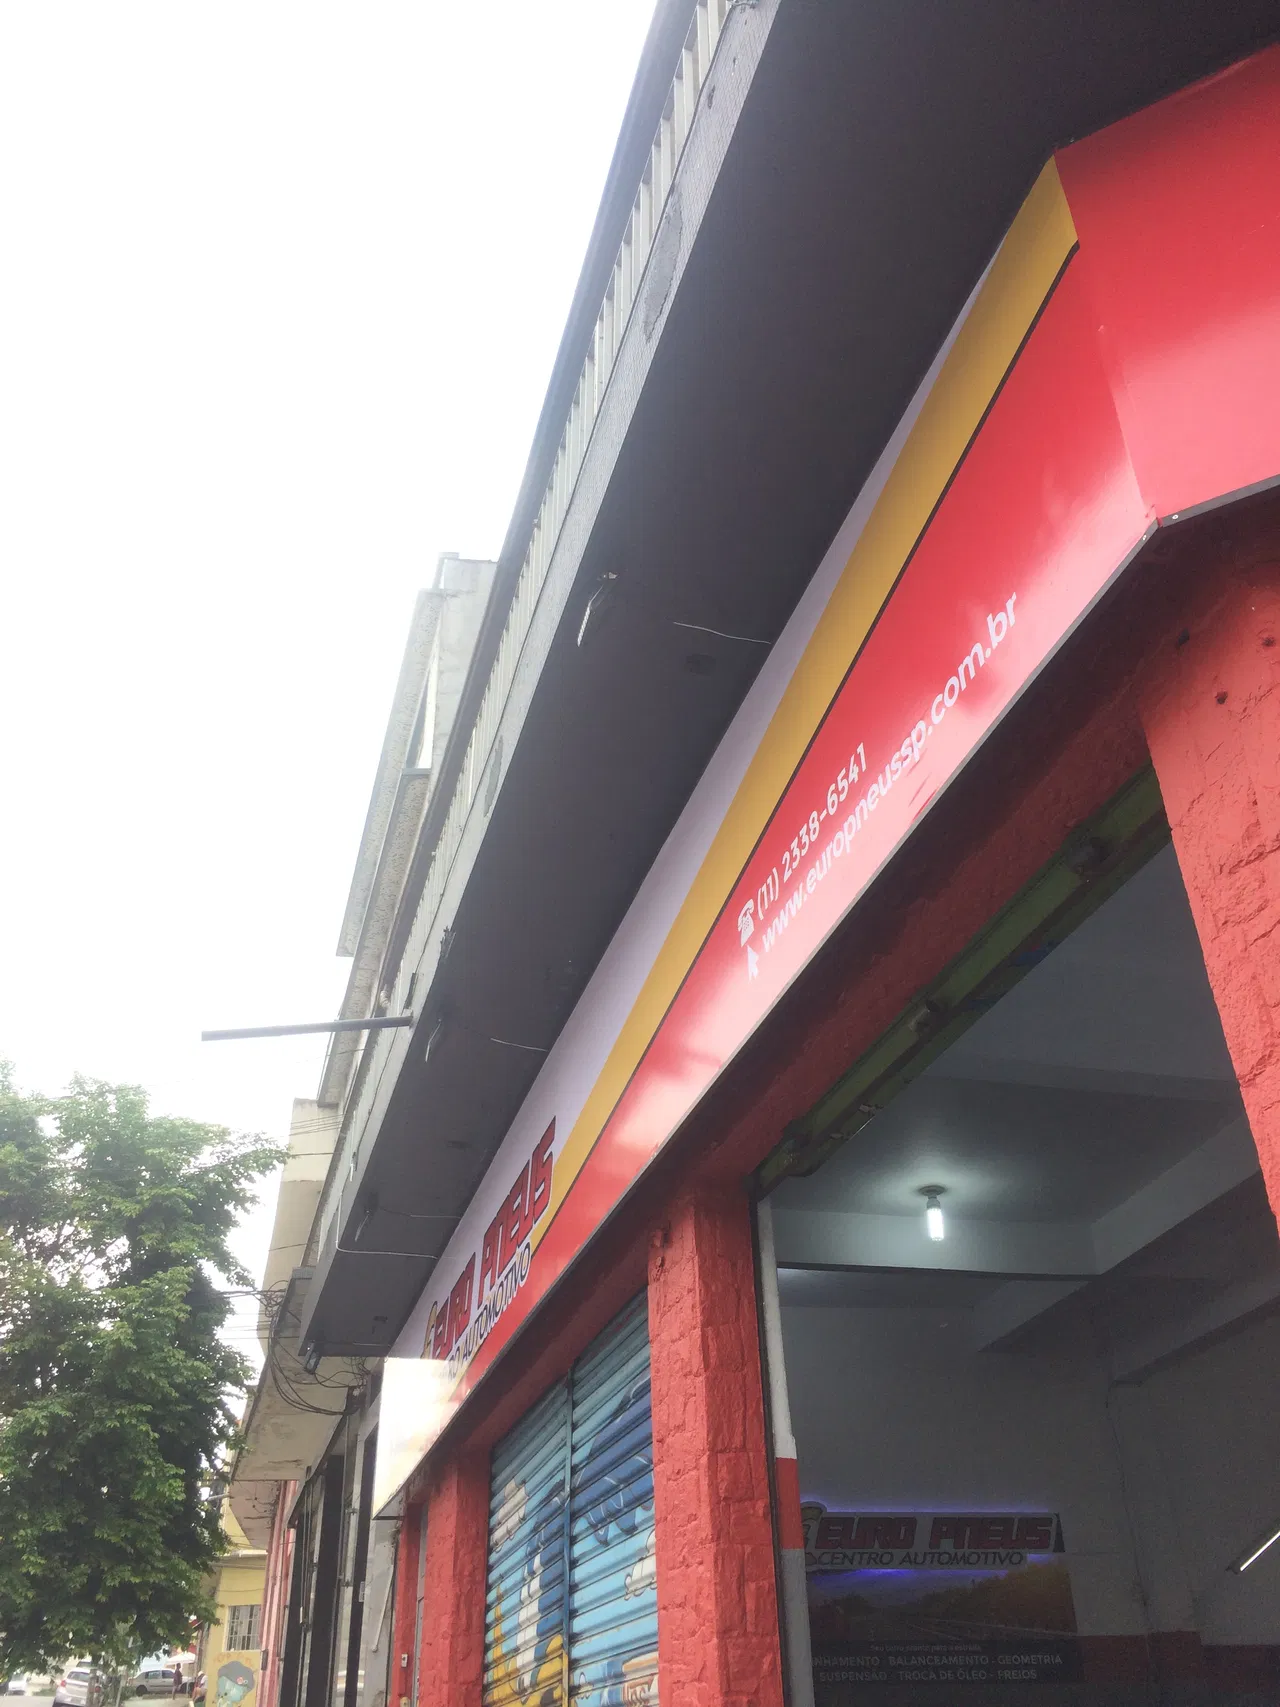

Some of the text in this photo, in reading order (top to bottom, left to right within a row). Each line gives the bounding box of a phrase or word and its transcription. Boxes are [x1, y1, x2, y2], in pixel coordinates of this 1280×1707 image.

[762, 592, 1017, 953] www.europneussp.com.br
[757, 742, 867, 921] (11) 2338-6541
[815, 1516, 917, 1549] EURO
[817, 1551, 1024, 1566] CENTRO AUTOMOTIVO
[812, 1656, 880, 1667] NHAMENTO
[888, 1655, 989, 1666] BALANCEAMENTO
[997, 1654, 1063, 1665] GEOMETRIA
[898, 1670, 937, 1681] TROCA
[940, 1670, 954, 1681] DE
[997, 1669, 1037, 1680] FREIOS
